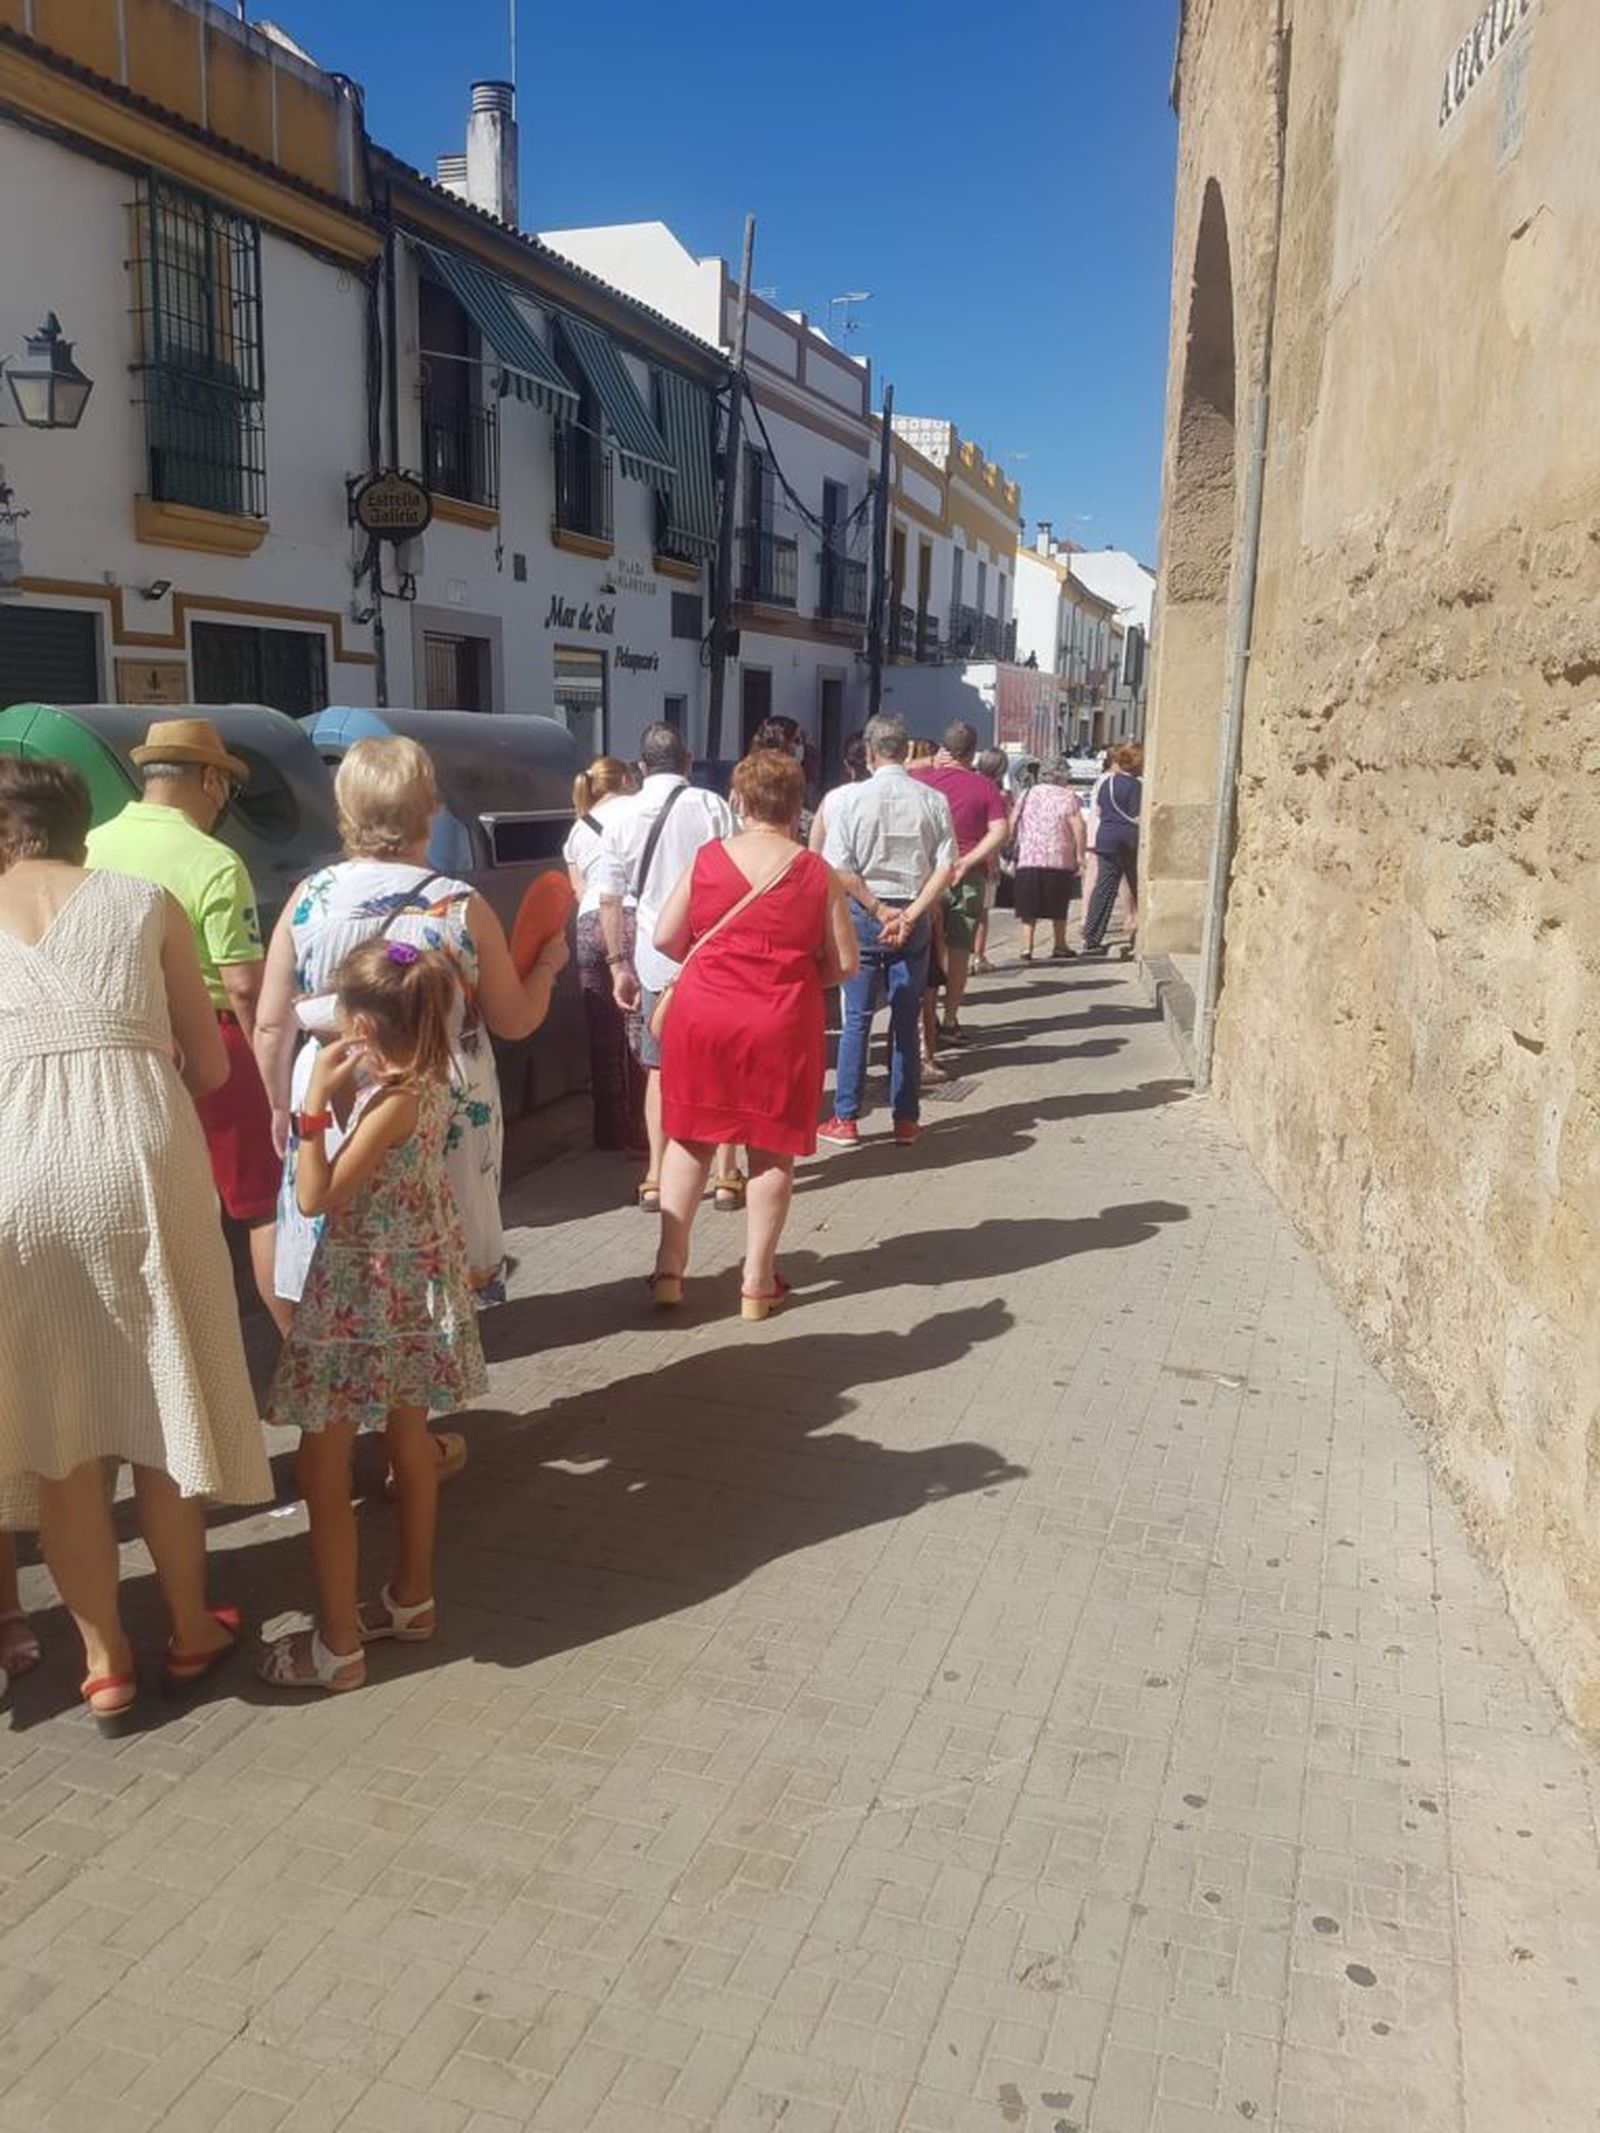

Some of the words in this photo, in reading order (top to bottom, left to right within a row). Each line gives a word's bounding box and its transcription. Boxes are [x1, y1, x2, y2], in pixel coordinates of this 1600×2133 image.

[1438, 0, 1530, 128] AUXIL
[367, 491, 419, 507] Estrella
[369, 508, 418, 523] Galicia
[544, 594, 577, 629] Mar
[578, 603, 594, 632] de
